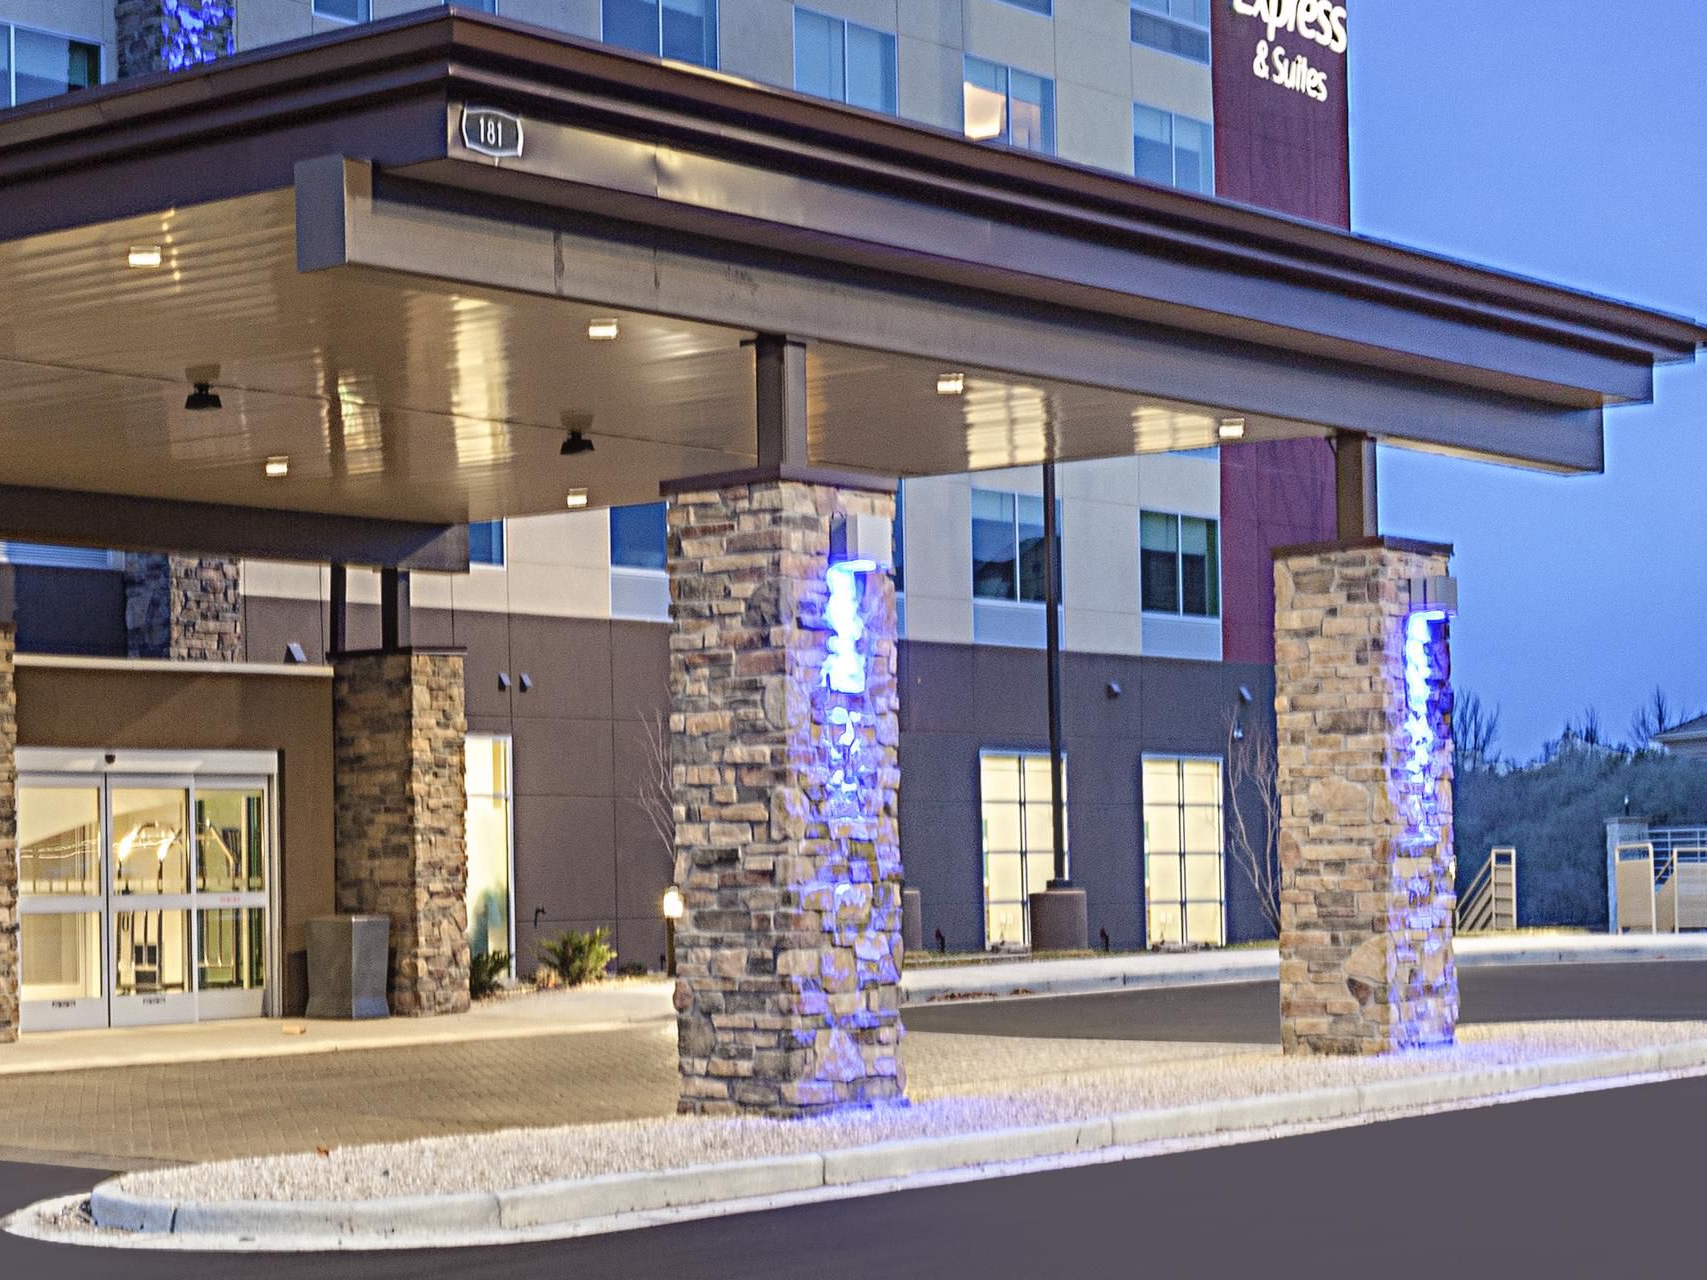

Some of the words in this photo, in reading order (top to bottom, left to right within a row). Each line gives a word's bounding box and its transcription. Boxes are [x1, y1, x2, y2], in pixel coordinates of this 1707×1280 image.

[1253, 39, 1270, 80] &
[1270, 49, 1329, 103] Suites
[479, 116, 502, 148] 181
